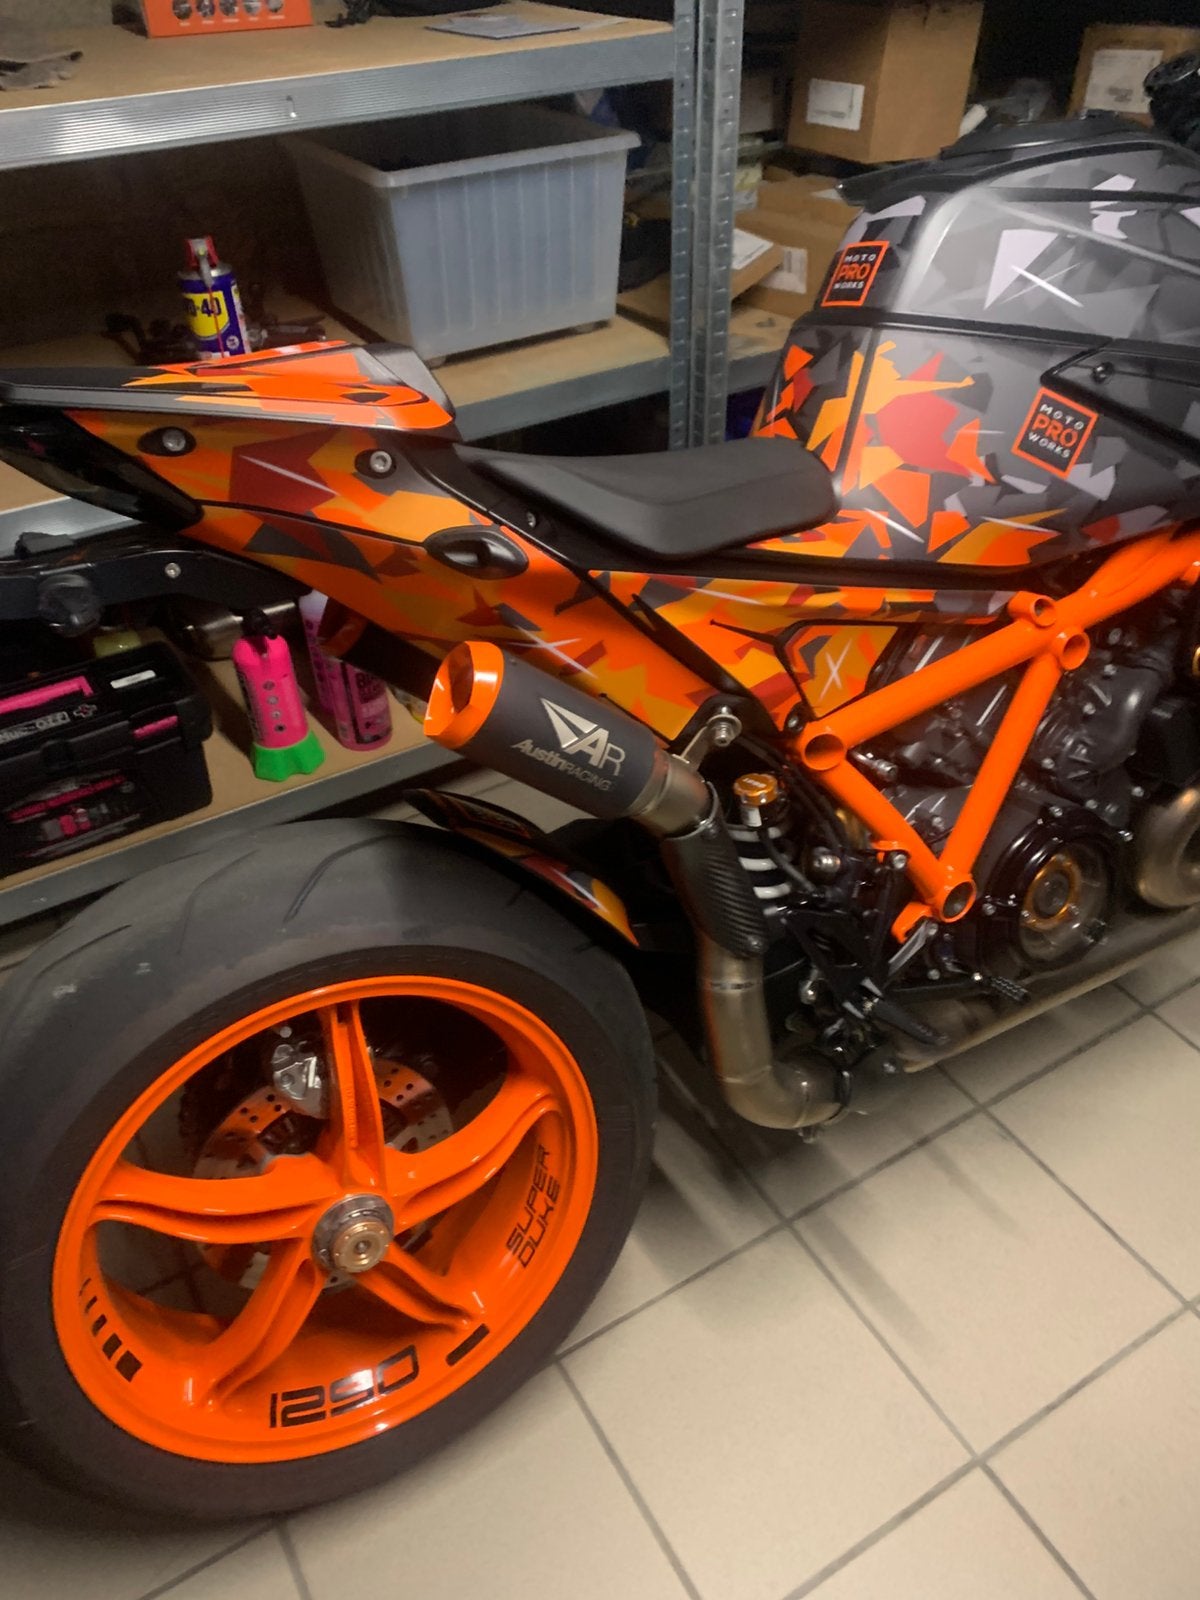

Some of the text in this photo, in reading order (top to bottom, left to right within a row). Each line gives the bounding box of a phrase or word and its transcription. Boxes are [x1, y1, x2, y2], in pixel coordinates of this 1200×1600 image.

[836, 262, 871, 280] PRO
[844, 253, 877, 262] MOTO
[1031, 413, 1079, 448] PRO
[1039, 403, 1085, 431] MOTO
[1027, 431, 1071, 459] WORKS
[506, 1144, 550, 1256] SUPER
[518, 1175, 560, 1268] DUKE
[269, 1344, 420, 1428] 1290
